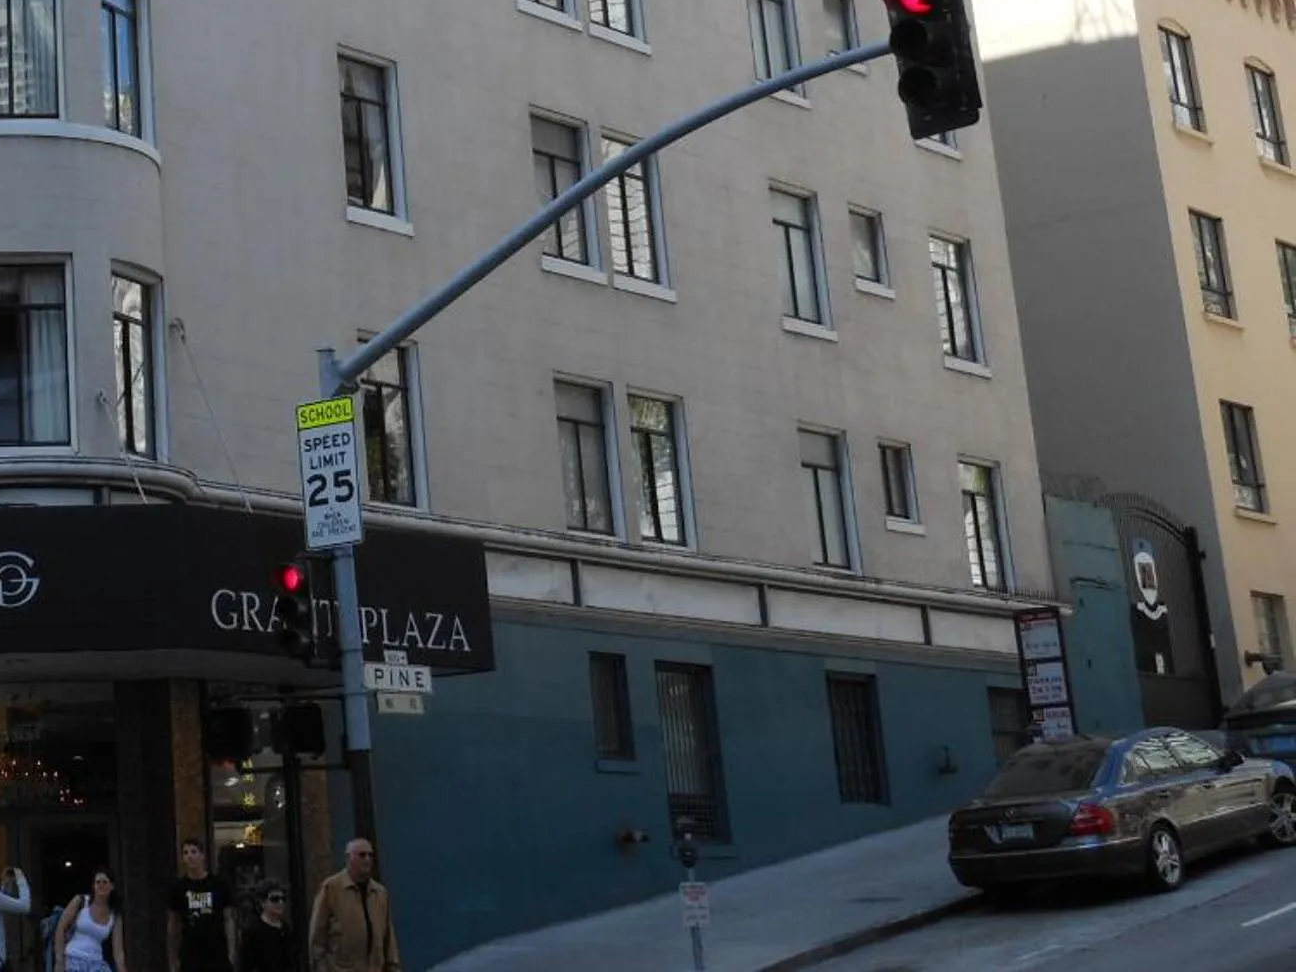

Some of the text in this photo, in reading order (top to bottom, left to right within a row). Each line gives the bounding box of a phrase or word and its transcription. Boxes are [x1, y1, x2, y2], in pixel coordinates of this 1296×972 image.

[300, 402, 351, 424] SCHOOL
[304, 432, 351, 453] SPEED
[309, 452, 346, 469] LIMIT
[307, 469, 354, 507] 25
[211, 589, 472, 652] GRAT PLAZA
[374, 668, 425, 688] PINE
